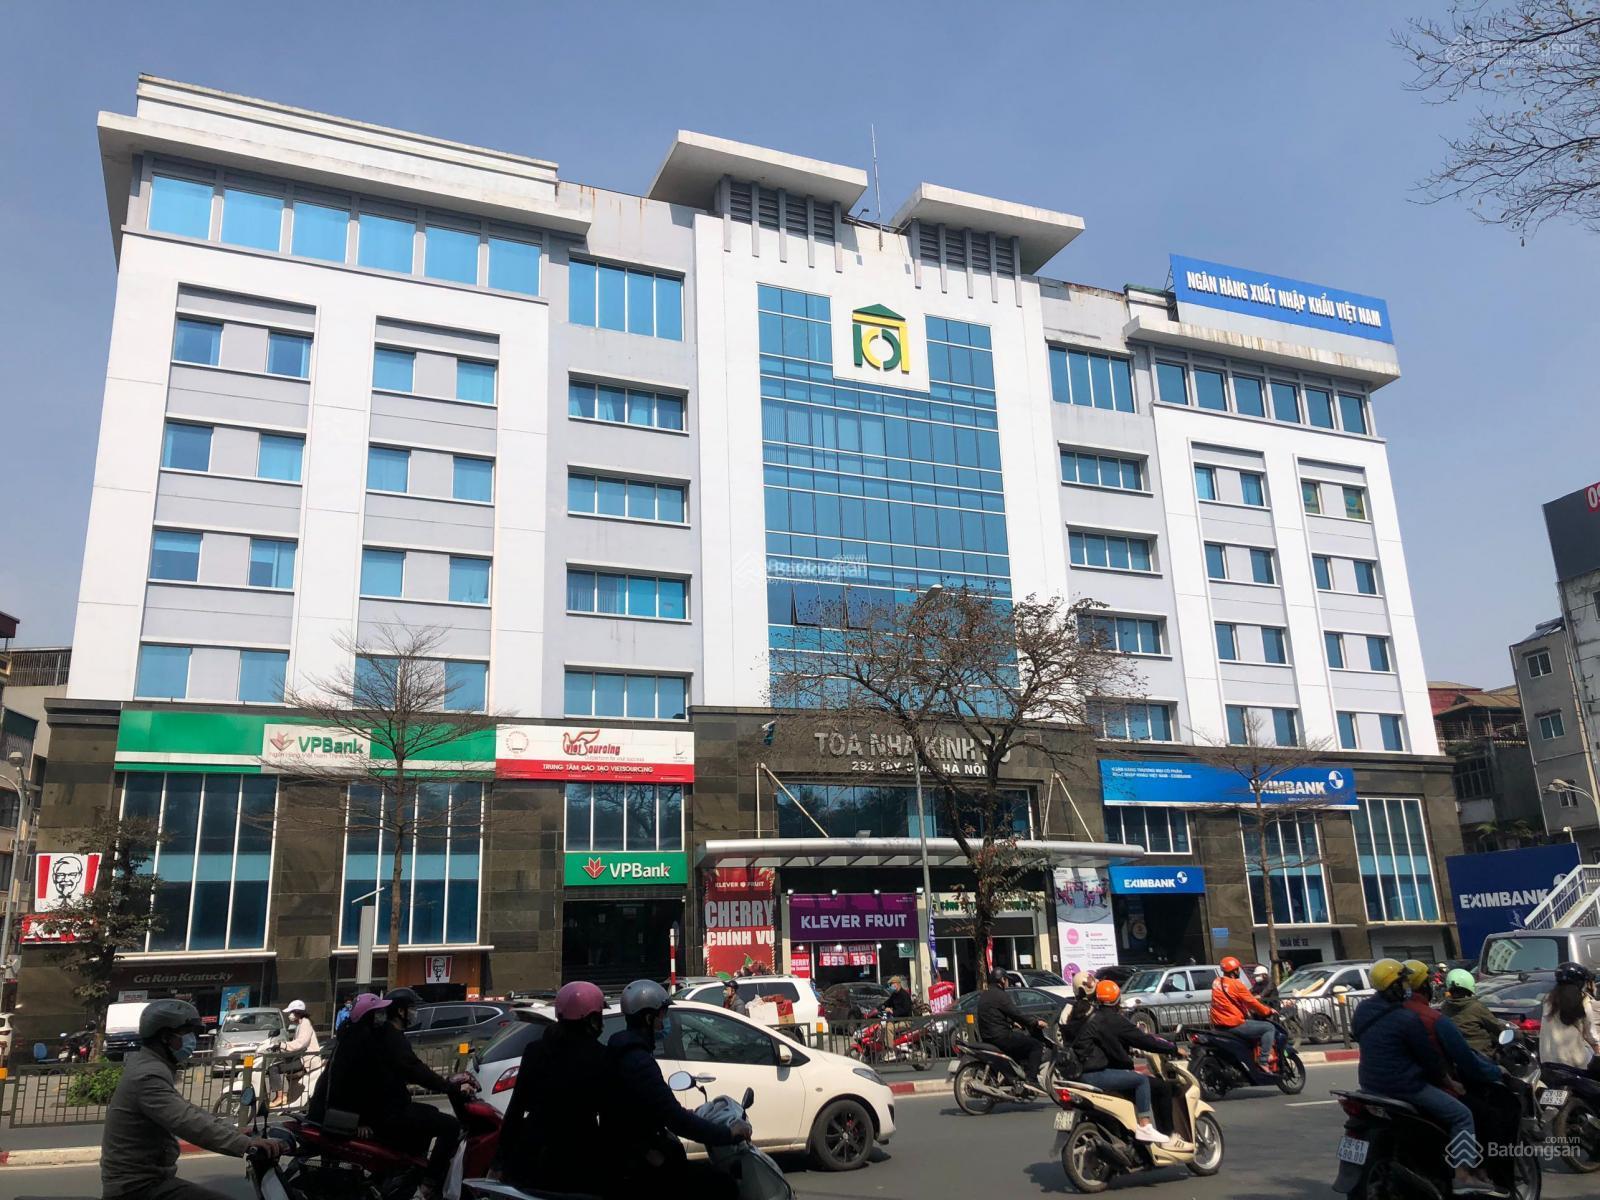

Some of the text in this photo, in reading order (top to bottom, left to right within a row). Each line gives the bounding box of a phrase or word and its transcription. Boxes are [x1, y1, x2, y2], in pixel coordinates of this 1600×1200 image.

[1186, 271, 1381, 327] NGÂN HÀNG XUẤT NHẬP KHẨU VIỆT NAM
[298, 735, 364, 754] VPBank
[814, 729, 864, 756] TÒA
[924, 735, 976, 761] KINH
[542, 763, 564, 771] TRUNG
[852, 761, 875, 771] 292
[942, 761, 960, 773] HÀ
[964, 763, 986, 776] NỘI
[609, 862, 671, 878] VPBank
[1123, 878, 1176, 889] EXIMBANK
[1459, 888, 1549, 909] EXIMBANK
[704, 900, 774, 928] CHERRY
[801, 914, 908, 929] KLEVER FRUIT
[707, 929, 752, 946] CHÍNH
[822, 955, 846, 966] 599
[852, 954, 874, 966] 599
[179, 972, 233, 982] Kentucky
